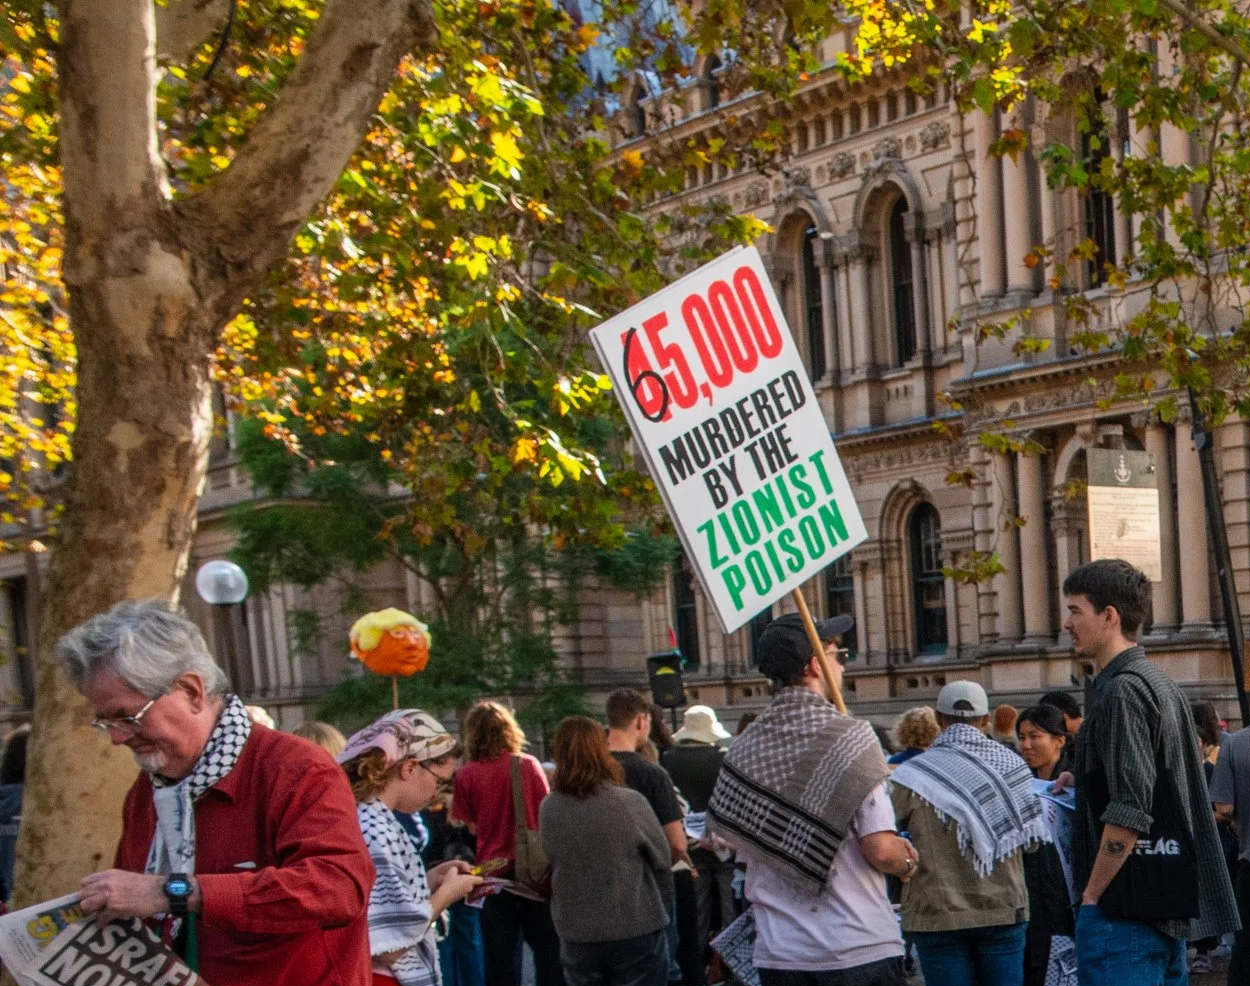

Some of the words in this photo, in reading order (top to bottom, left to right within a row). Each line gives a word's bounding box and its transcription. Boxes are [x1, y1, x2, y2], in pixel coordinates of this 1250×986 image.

[658, 369, 806, 487] MURDERED
[702, 457, 744, 510] BY
[743, 423, 799, 481] THE
[697, 450, 835, 570] ZIONIST
[721, 499, 850, 612] POISON
